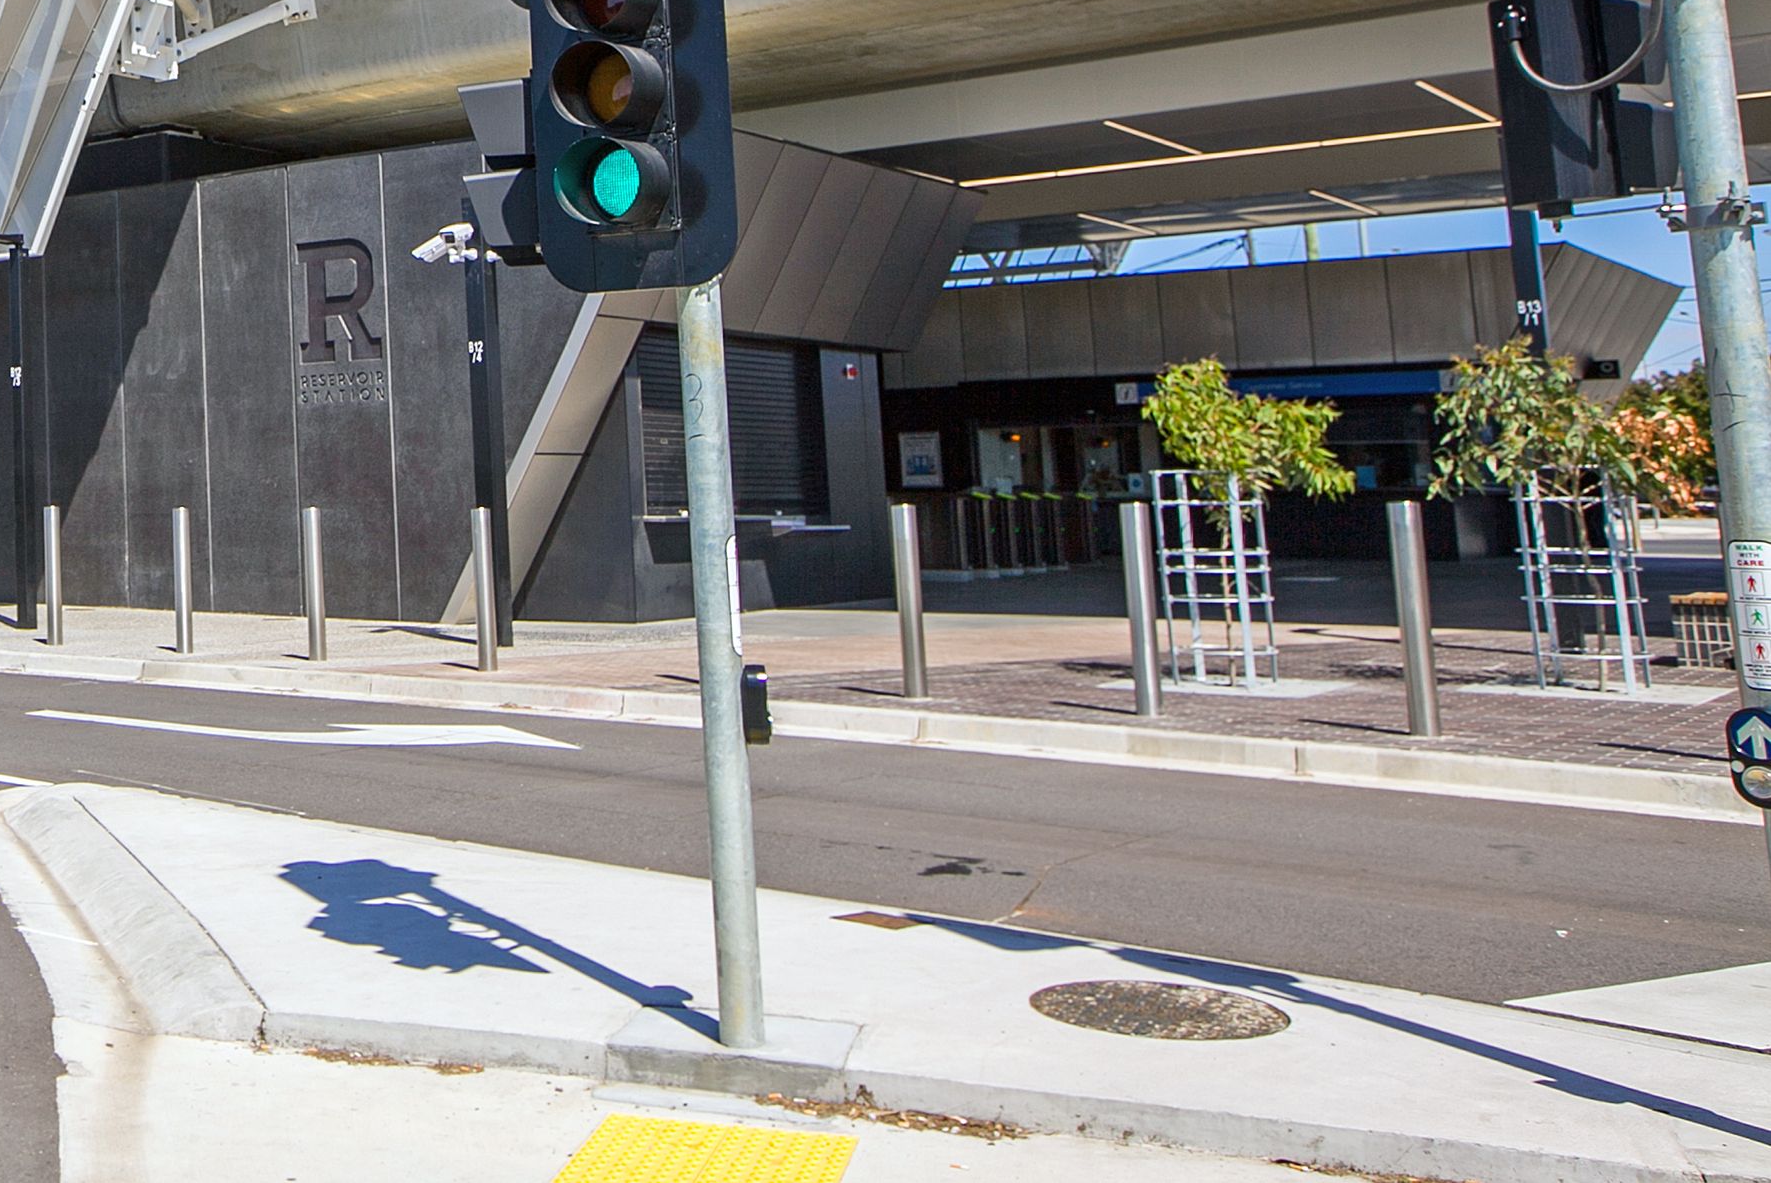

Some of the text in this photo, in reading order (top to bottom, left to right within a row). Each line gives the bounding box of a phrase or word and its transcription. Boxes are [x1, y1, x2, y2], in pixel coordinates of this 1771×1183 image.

[295, 238, 382, 365] R
[1517, 299, 1542, 314] B13
[468, 340, 484, 353] B12
[300, 371, 385, 389] RESERVOIR
[301, 388, 386, 404] STATION
[1737, 559, 1765, 567] CARE
